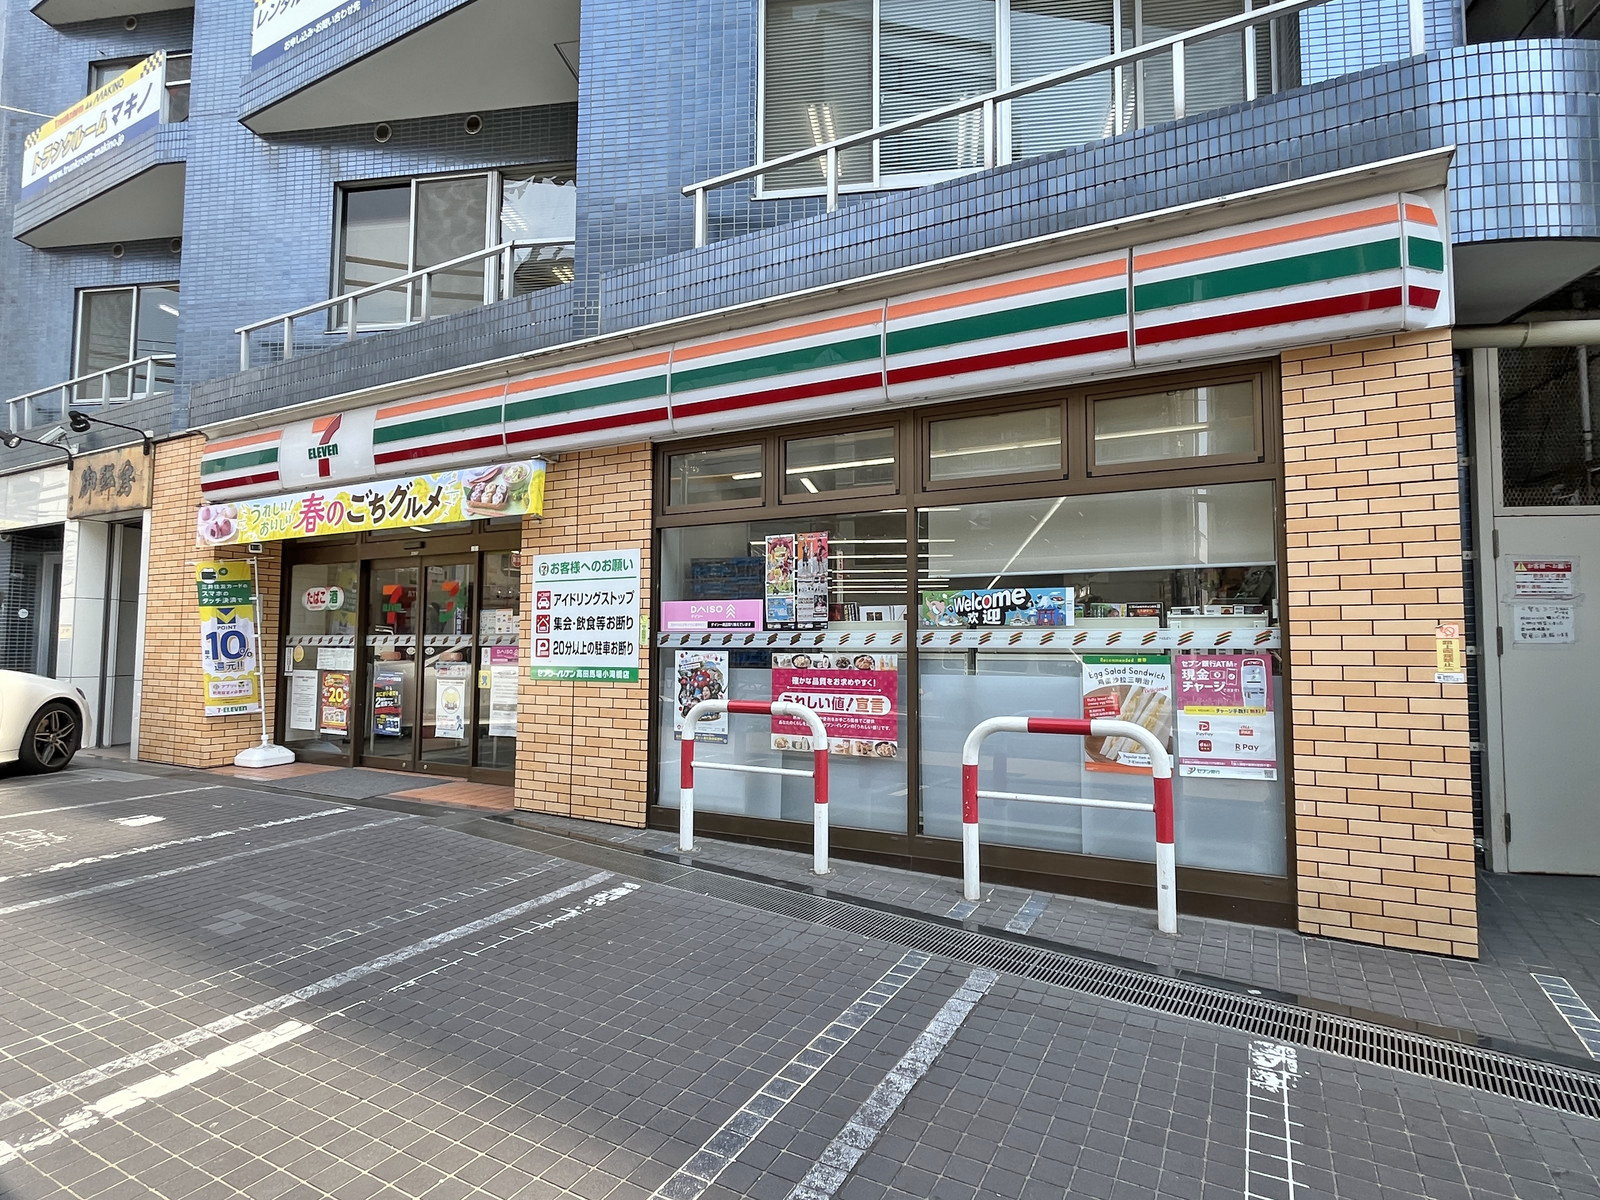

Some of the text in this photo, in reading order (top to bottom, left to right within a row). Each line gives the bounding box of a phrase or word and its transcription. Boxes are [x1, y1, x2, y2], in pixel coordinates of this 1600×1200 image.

[111, 82, 153, 126] マキノ
[550, 558, 634, 575] お客様へのお願い
[306, 591, 326, 604] たばこ
[553, 589, 635, 607] アイドリングストップ
[953, 588, 1028, 613] Welcome
[690, 605, 723, 613] DAISO
[552, 640, 634, 656] 20分以上の駐車お断り
[1104, 667, 1127, 676] Salad
[1128, 667, 1166, 680] Sandwich
[1181, 668, 1210, 681] 現金
[1182, 681, 1226, 693] チャージ
[1242, 744, 1260, 752] Pay
